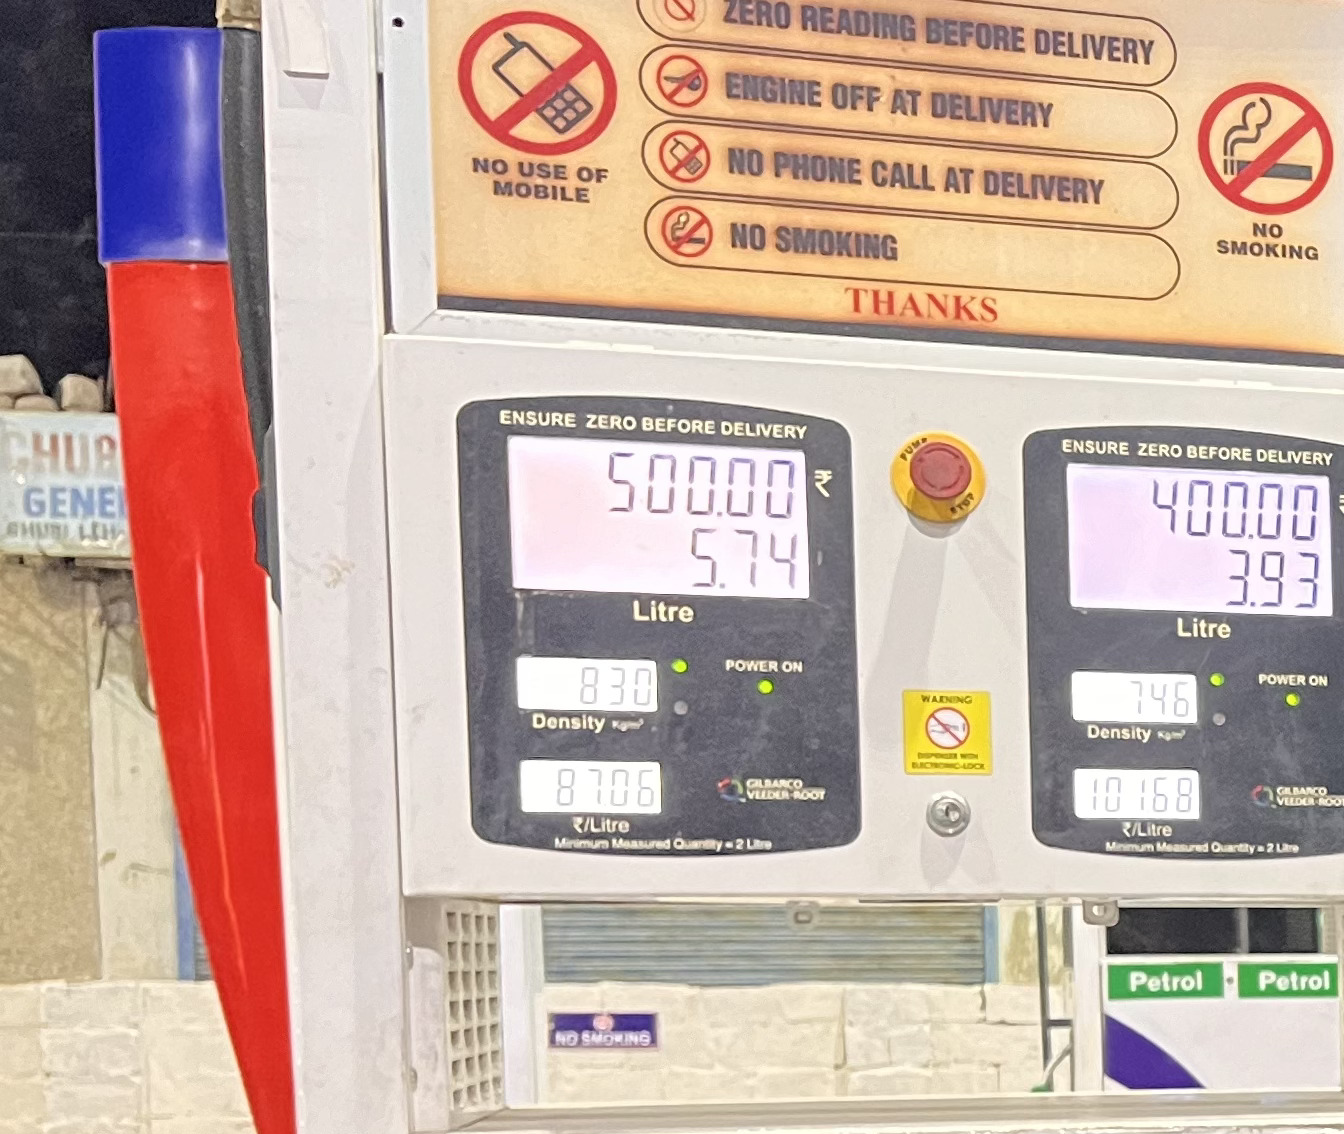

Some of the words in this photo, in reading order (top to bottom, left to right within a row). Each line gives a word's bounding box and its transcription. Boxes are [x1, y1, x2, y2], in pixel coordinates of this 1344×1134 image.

[723, 0, 791, 30] ZERO
[801, 3, 915, 44] READING
[926, 18, 1026, 54] BEFORE
[1034, 28, 1155, 66] DELIVERY
[725, 71, 822, 108] ENGINE
[832, 83, 881, 113] OFF
[891, 88, 921, 117] AT
[931, 92, 1054, 128] DELIVERY
[471, 157, 508, 176] NO
[518, 160, 568, 182] USE
[579, 167, 609, 186] OF
[728, 147, 764, 177] NO
[774, 151, 862, 187] PHONE
[871, 160, 935, 191] CALL
[943, 168, 974, 194] AT
[983, 170, 1105, 206] DELIVERY
[492, 180, 591, 204] MOBILE
[730, 222, 766, 251] NO
[775, 225, 898, 262] SMOKING
[1251, 222, 1284, 240] NO
[1216, 239, 1320, 262] SMOKING
[844, 287, 999, 324] THANKS
[499, 409, 577, 429] ENSURE
[586, 413, 637, 432] ZERO
[641, 416, 716, 436] BEFORE
[720, 420, 808, 440] DELIVERY
[1062, 438, 1130, 457] ENSURE
[1137, 441, 1183, 459] ZERO
[1187, 444, 1253, 462] BEFORE
[1256, 448, 1334, 467] DELIVERY
[607, 451, 797, 521] 500.00
[23, 485, 129, 519] GENE
[1151, 479, 1319, 541] 400.00
[691, 527, 798, 590] 5.74
[1224, 549, 1320, 609] 3.93
[632, 600, 695, 623] Litre
[1176, 617, 1231, 639] Litre
[725, 659, 778, 672] POWER
[781, 660, 804, 673] ON
[579, 665, 653, 706] 830
[1258, 674, 1306, 686] POWER
[1308, 675, 1329, 687] ON
[1130, 680, 1190, 718] 746
[531, 712, 606, 734] Density
[1086, 724, 1152, 744] Density
[746, 778, 804, 789] GILBARCO
[1276, 786, 1328, 796] GILBARCO
[554, 836, 610, 850] Minimum
[612, 838, 671, 850] Measured
[672, 838, 723, 853] Quantity
[736, 838, 745, 849] 2
[746, 838, 773, 850] Litre
[1105, 841, 1155, 852] Minimum
[1156, 842, 1209, 853] Measured
[1210, 842, 1255, 855] Quantity
[1276, 843, 1300, 853] Litre
[1129, 969, 1203, 992] Petrol
[1258, 969, 1331, 992] Petrol
[555, 1030, 578, 1046] NO
[581, 1029, 651, 1047] SMOKING
